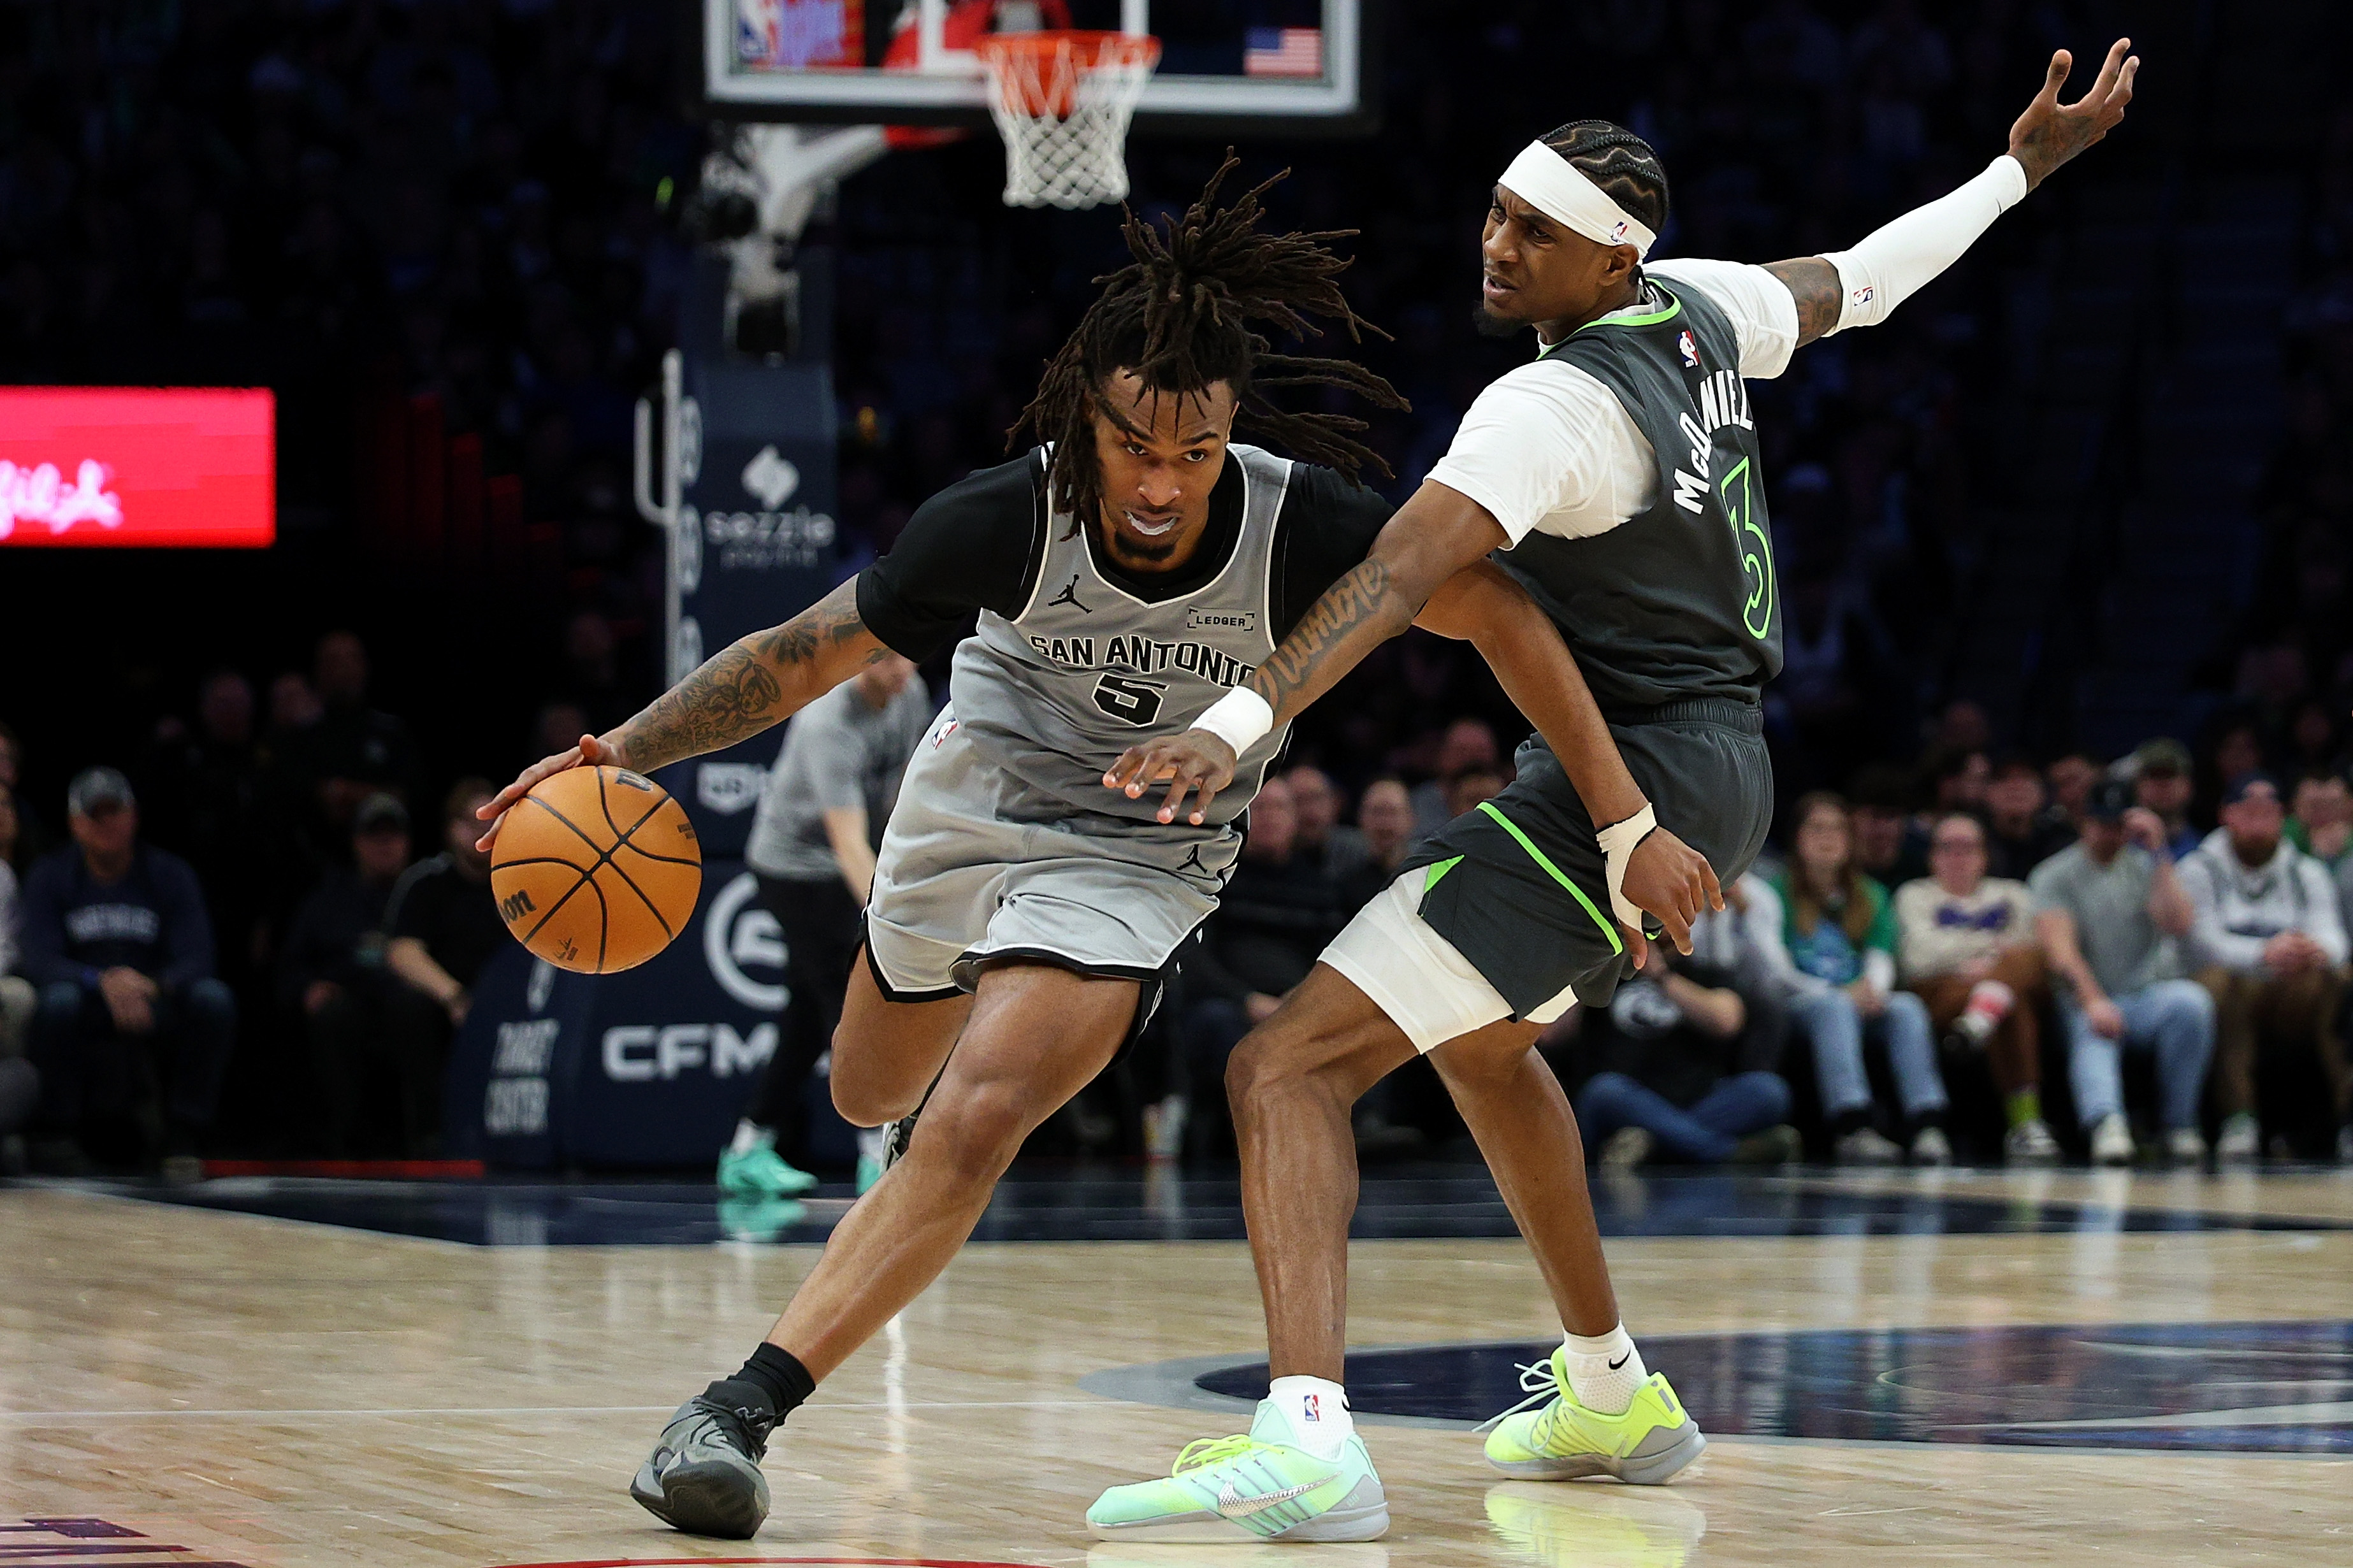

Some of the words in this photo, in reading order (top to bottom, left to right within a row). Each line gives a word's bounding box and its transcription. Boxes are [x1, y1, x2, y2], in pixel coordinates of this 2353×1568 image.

[1674, 368, 1753, 515] McDNIEL
[1721, 456, 1772, 639] 3
[1196, 615, 1246, 626] LEDGER
[1029, 635, 1095, 666] SAN
[1091, 672, 1171, 728] 5
[602, 1022, 781, 1082] CFM
